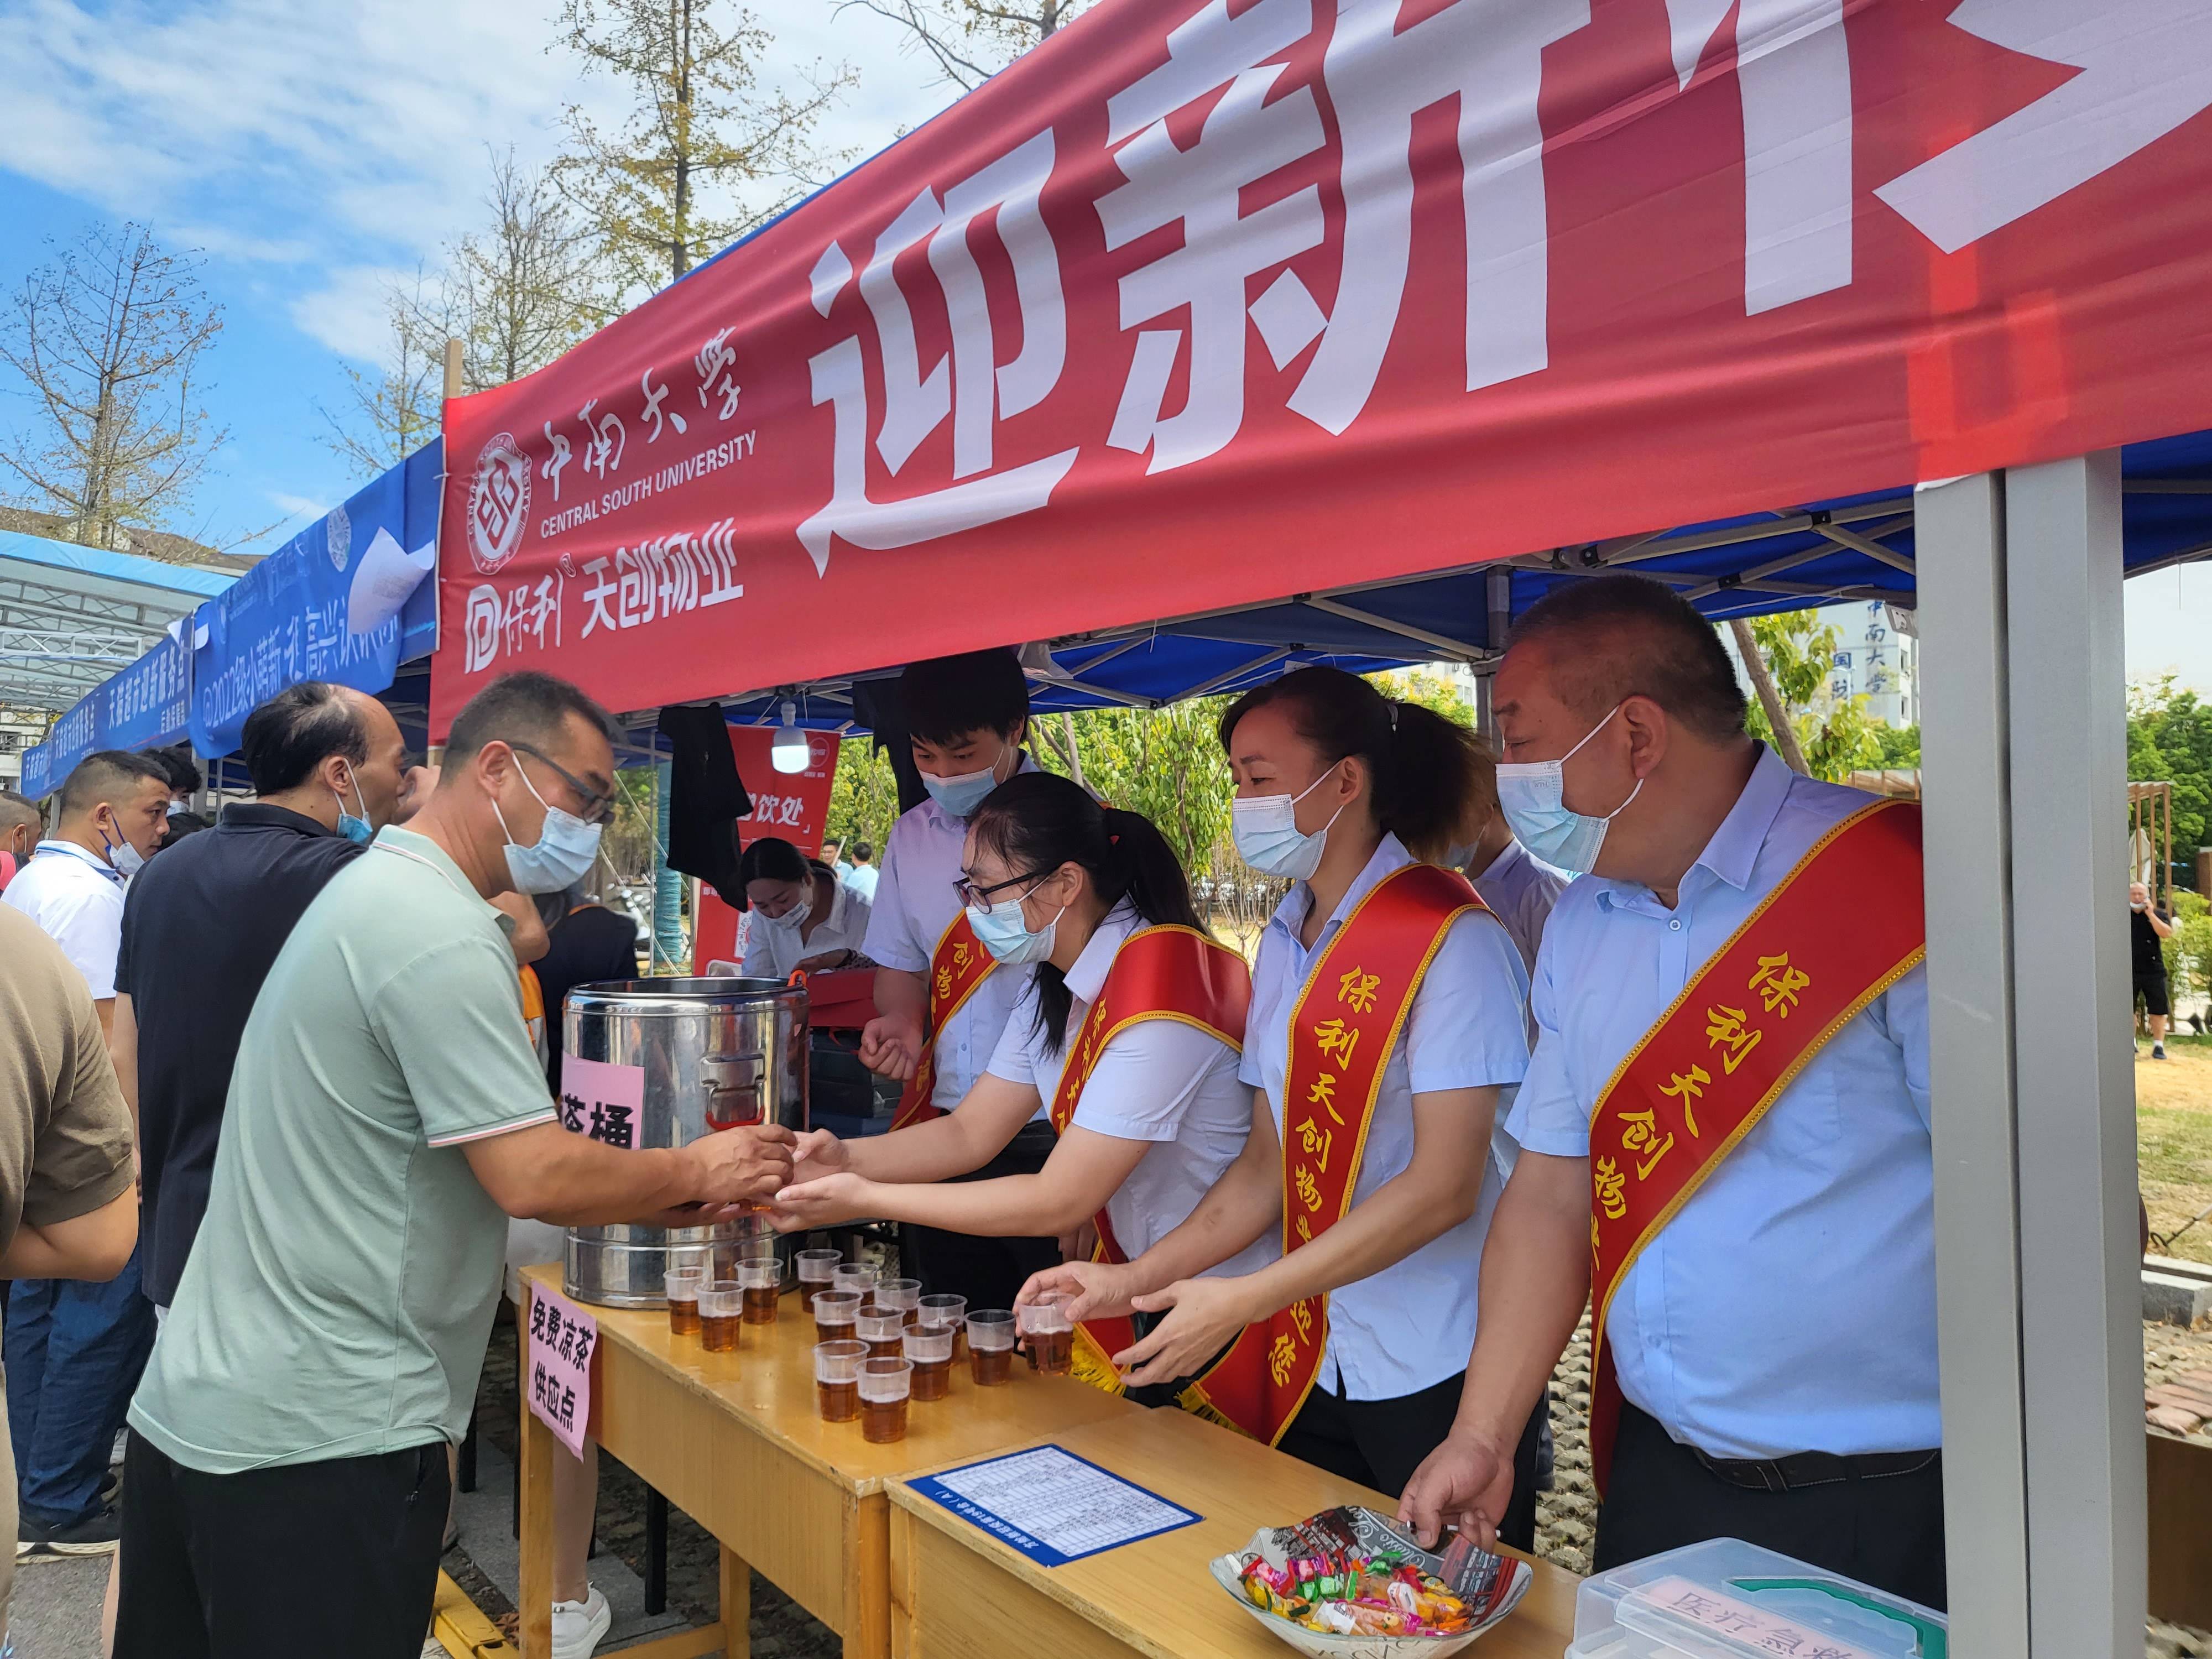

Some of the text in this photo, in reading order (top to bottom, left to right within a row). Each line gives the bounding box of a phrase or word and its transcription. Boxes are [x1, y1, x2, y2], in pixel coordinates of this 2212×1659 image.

[541, 326, 741, 501] 中南大学
[541, 430, 757, 539] CENTRAL SOUTH UNIVERSITY
[582, 517, 744, 640] 天创物业
[738, 792, 810, 833] 饮处」
[565, 1093, 634, 1149] 茶桶
[531, 1296, 593, 1373] 免费凉茶
[535, 1360, 576, 1433] 供应点
